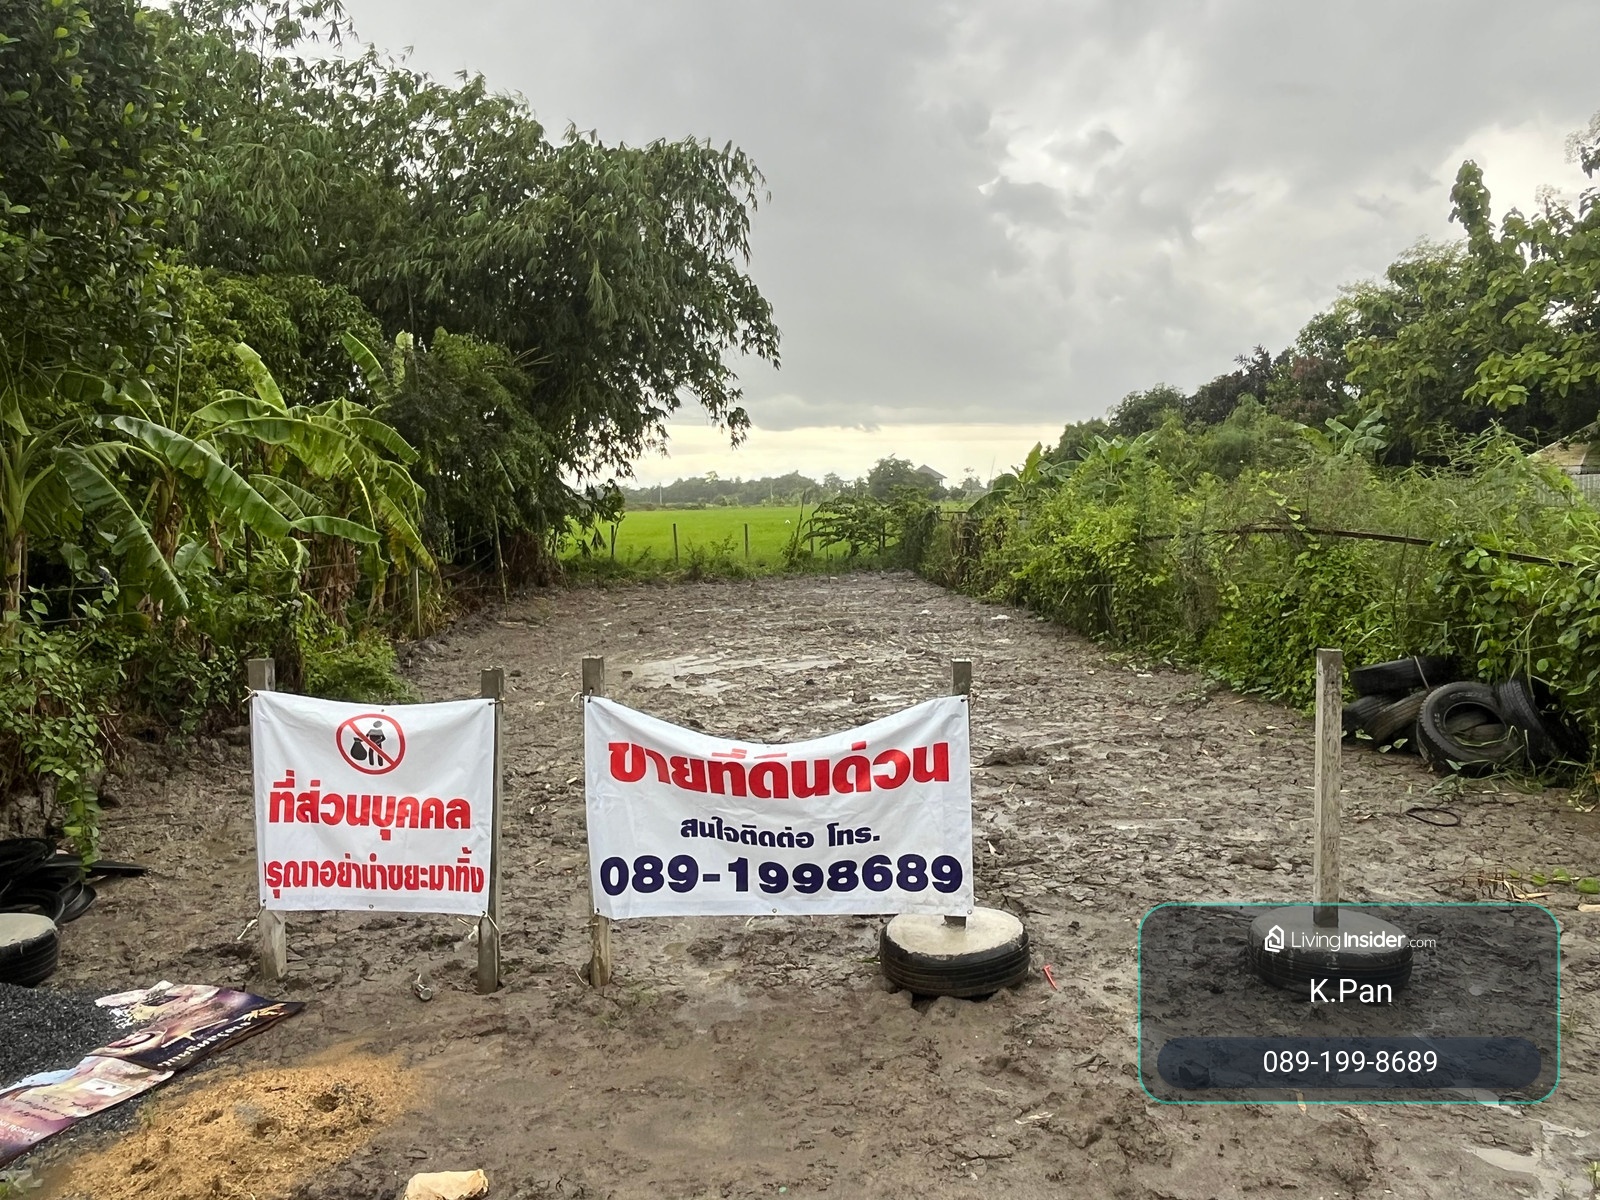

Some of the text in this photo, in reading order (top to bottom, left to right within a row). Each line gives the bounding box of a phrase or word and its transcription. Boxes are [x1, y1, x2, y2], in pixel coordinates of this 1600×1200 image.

[608, 741, 950, 799] ขายที่ดินด่วน
[269, 769, 471, 841] ที่ส่วนบุคคล
[680, 816, 881, 849] สนใจติดต่อ โทร.
[264, 846, 485, 899] รุณาอย่านำขยะมาทิ้ง
[599, 853, 963, 896] 089-1998689
